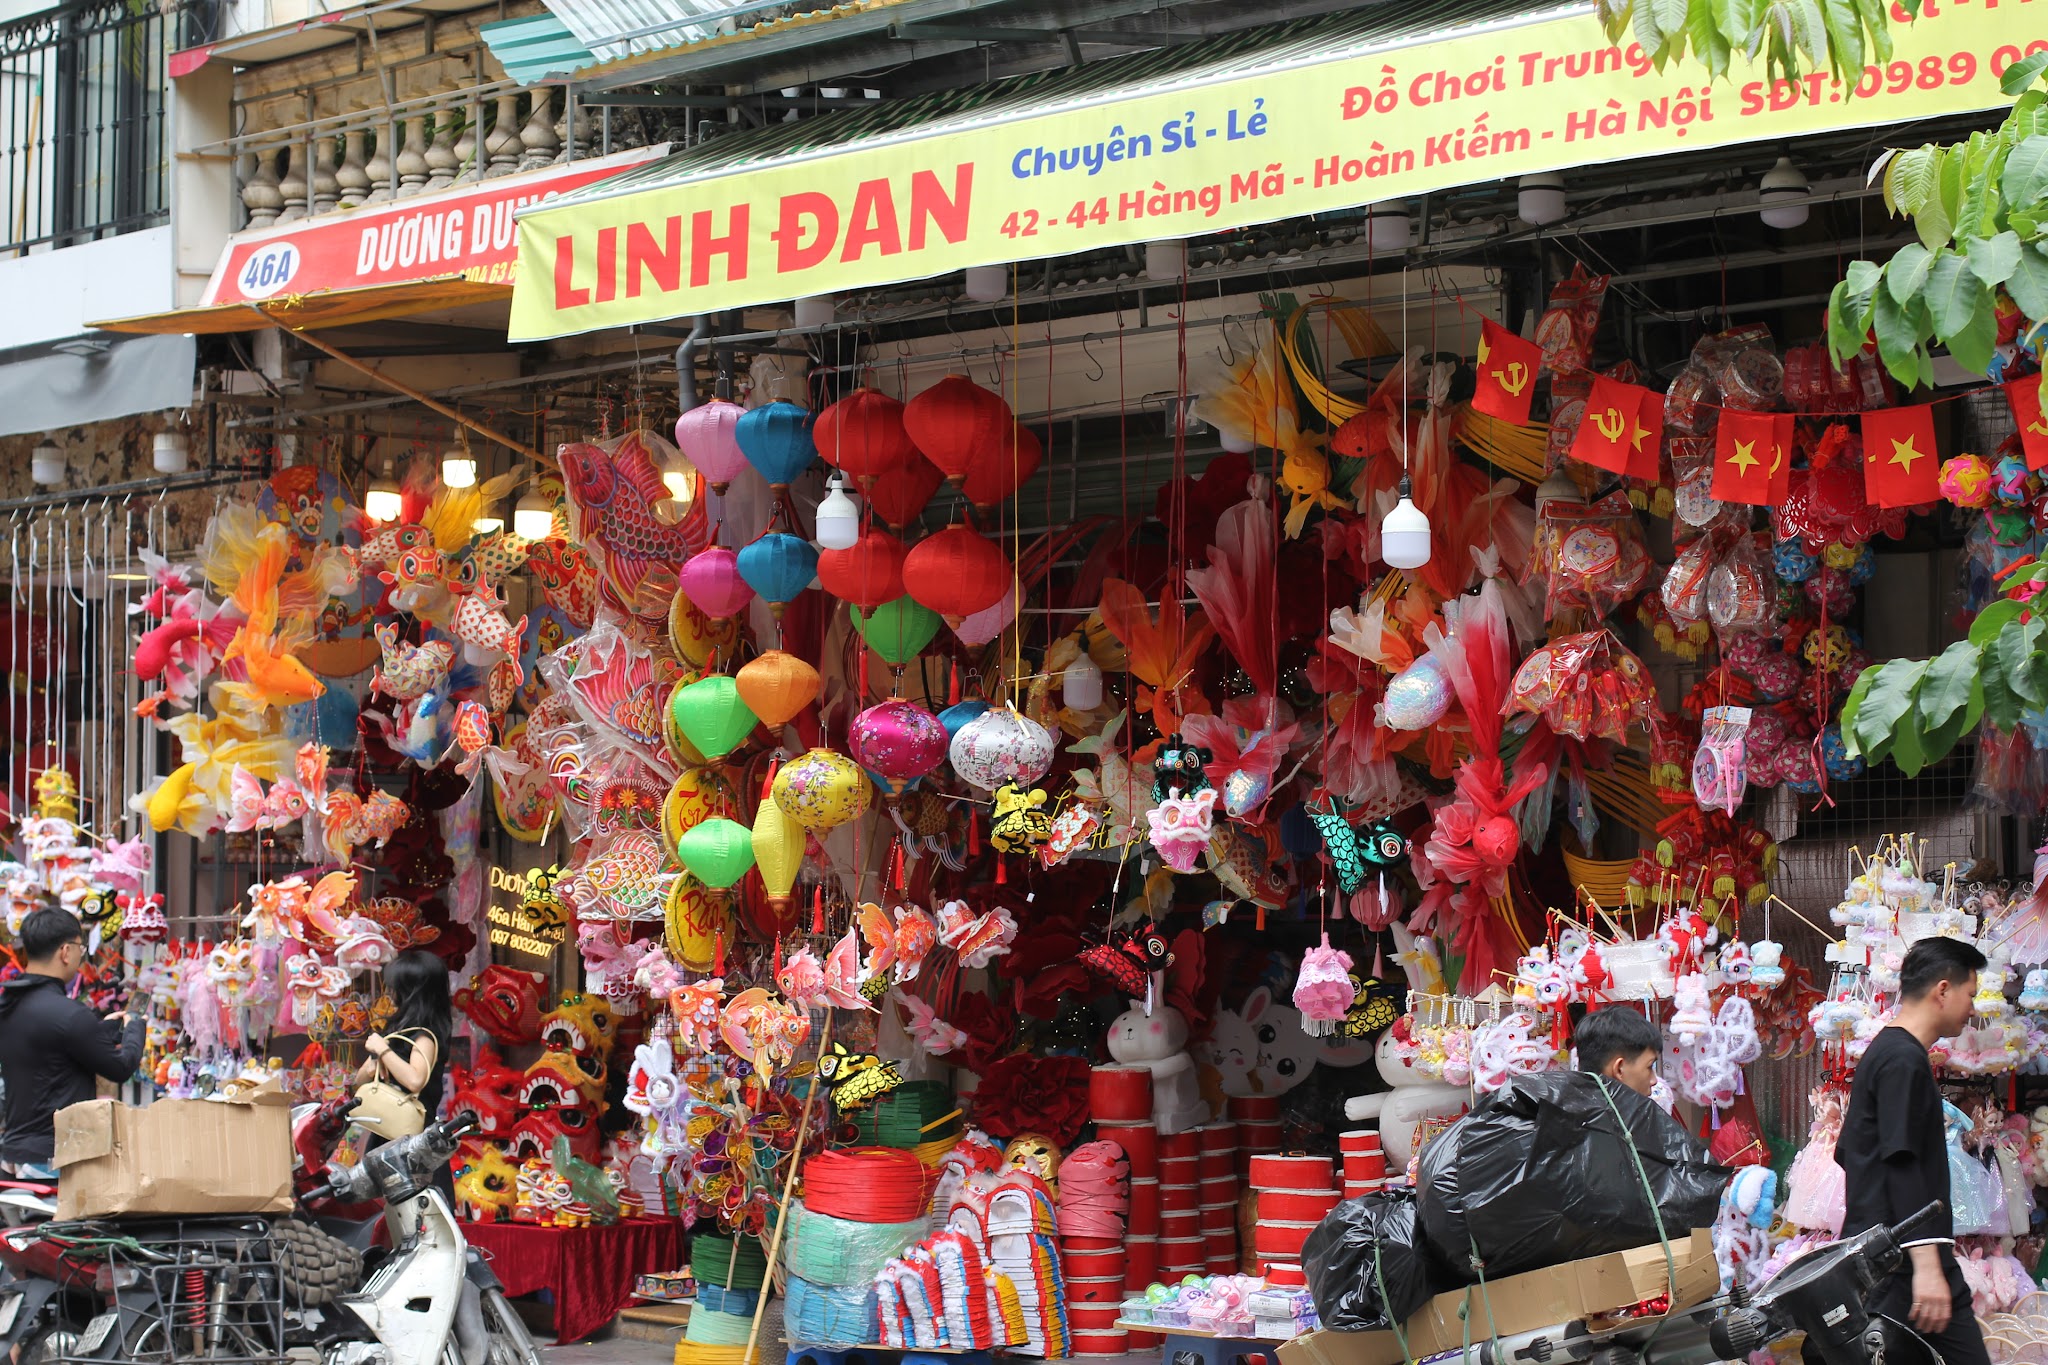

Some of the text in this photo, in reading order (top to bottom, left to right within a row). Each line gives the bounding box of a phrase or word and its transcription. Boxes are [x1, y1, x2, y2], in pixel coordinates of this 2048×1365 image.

[1340, 42, 1653, 121] Đồ Chơi Trung
[999, 208, 1039, 239] 42
[1065, 196, 1110, 229] 44
[1117, 180, 1222, 222] Hàng
[1229, 162, 1285, 204] Mã
[1313, 140, 1415, 189] Hoàn
[1423, 111, 1531, 168] Kiếm
[1564, 98, 1627, 143] Hà
[1636, 85, 1714, 138] Nội
[1854, 51, 1977, 99] 0989
[1011, 124, 1151, 179] Chuyên
[1161, 111, 1197, 153] Sỉ
[1226, 97, 1268, 141] Lẻ
[244, 249, 291, 290] 46A
[355, 208, 465, 276] DƯƠNG
[553, 161, 975, 311] LINH ĐAN
